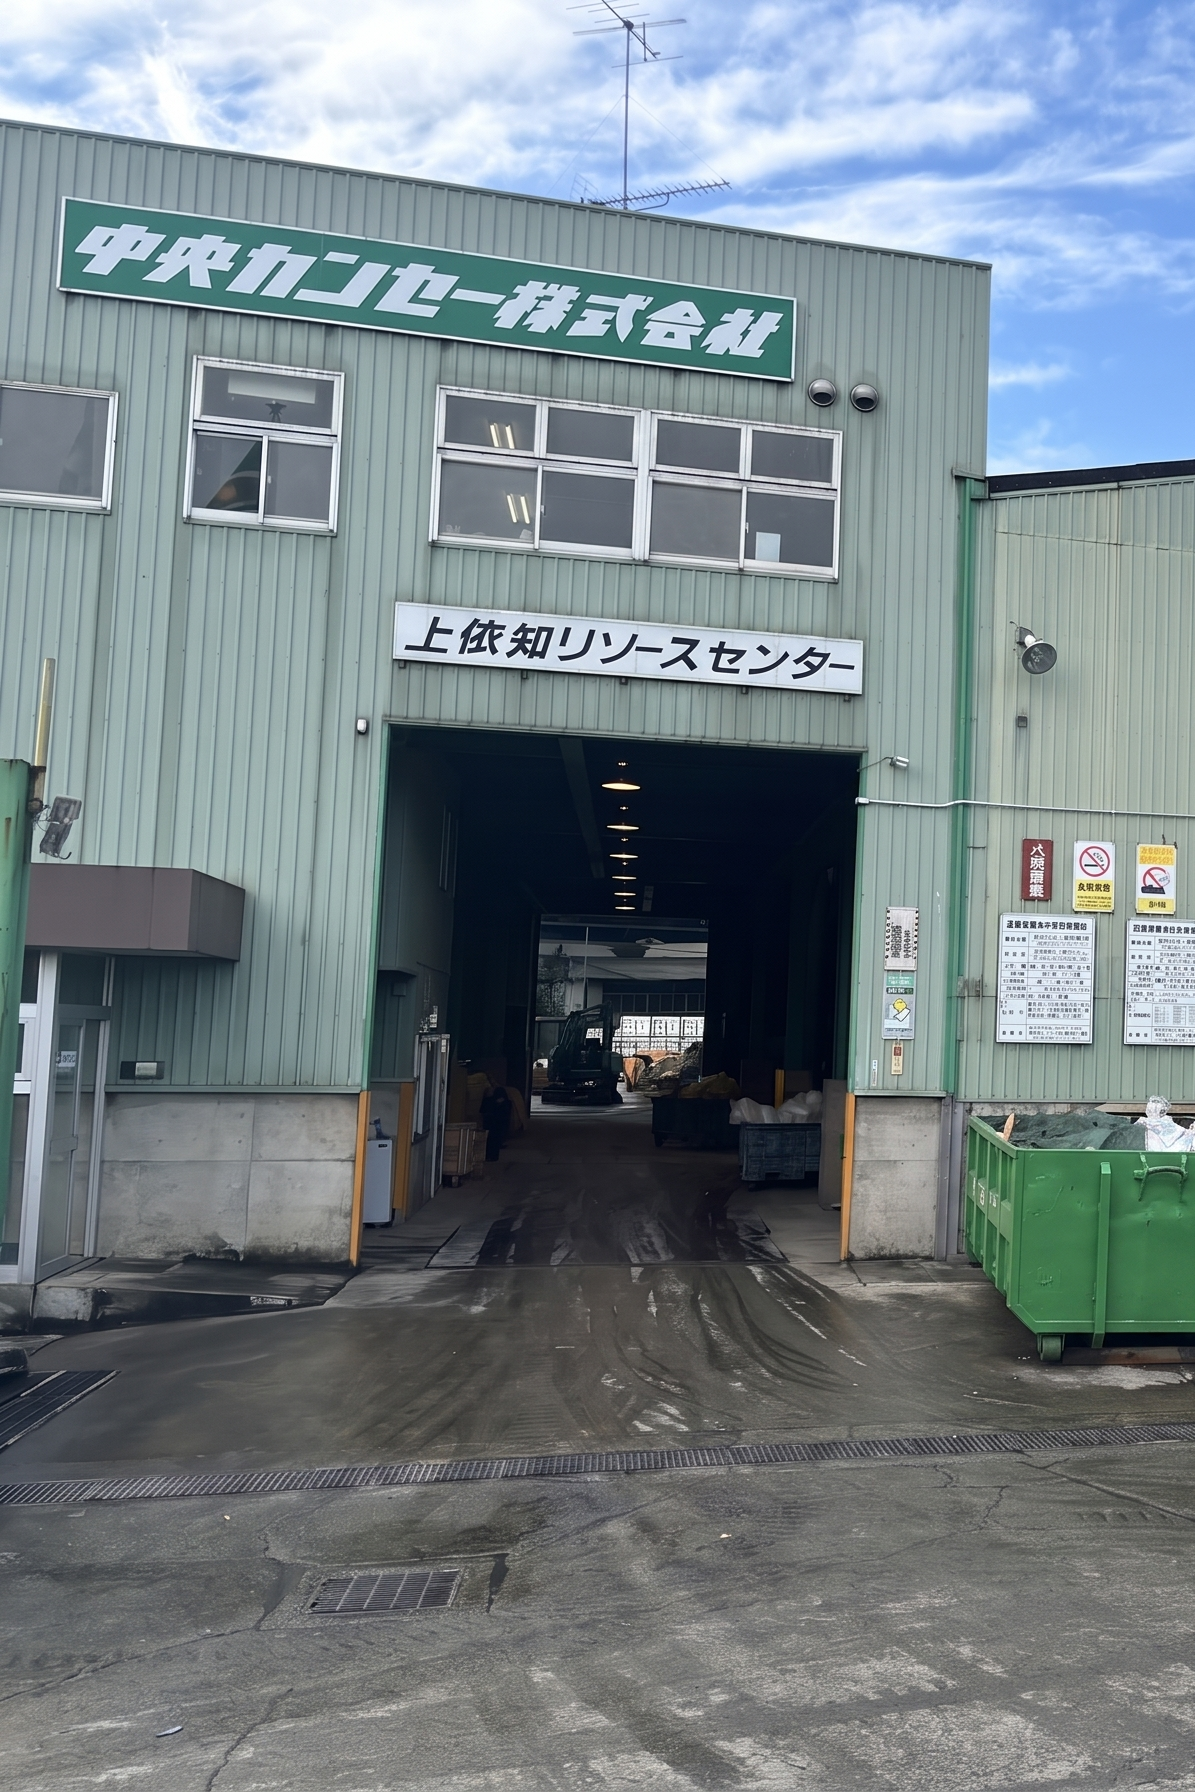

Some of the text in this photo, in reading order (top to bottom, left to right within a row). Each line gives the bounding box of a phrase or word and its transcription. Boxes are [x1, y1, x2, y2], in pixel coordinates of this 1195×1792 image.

[75, 223, 783, 359] 中央カンセー株式会社
[404, 616, 855, 680] 上依知リソースセンター
